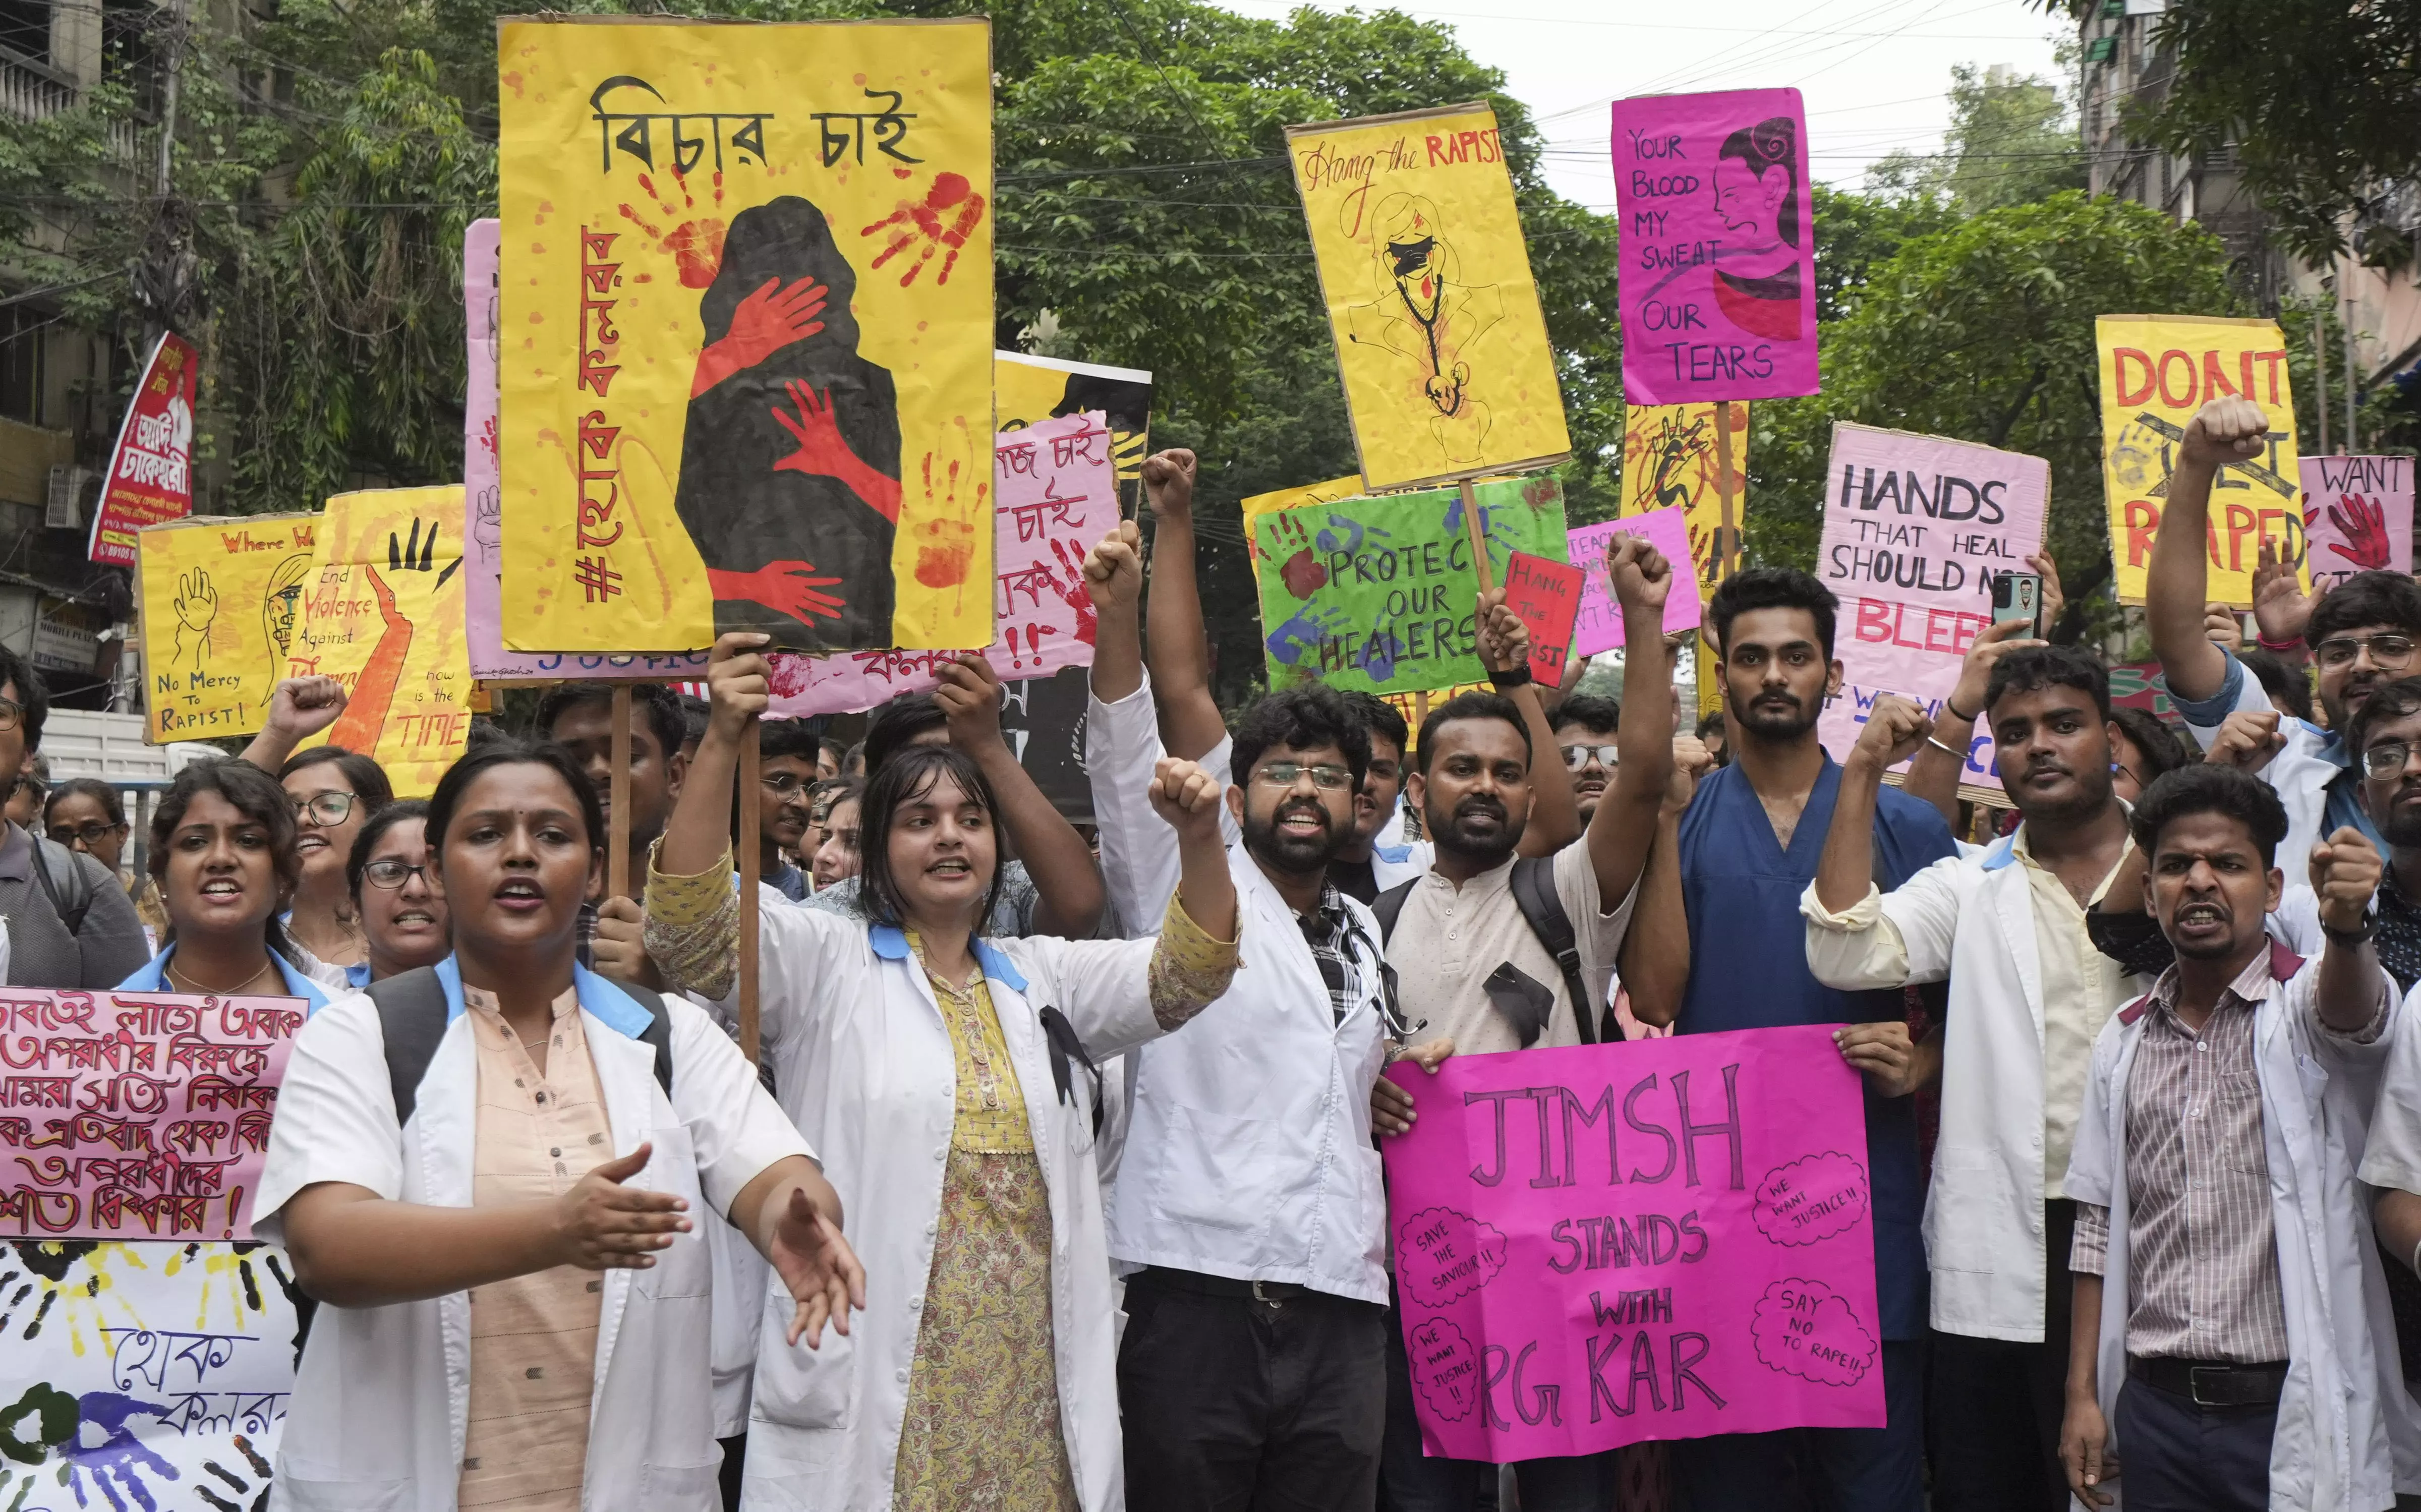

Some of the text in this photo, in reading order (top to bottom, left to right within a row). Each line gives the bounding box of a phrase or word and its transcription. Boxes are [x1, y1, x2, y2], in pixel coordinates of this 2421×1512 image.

[590, 75, 926, 176] বিচার চাই
[1628, 128, 1687, 160] YOUR
[1299, 129, 1503, 239] Hang the RAPIST
[1632, 169, 1699, 199] BLOOD
[1635, 210, 1669, 237] MY
[1641, 240, 1722, 270] SWEAT
[578, 225, 622, 397] কলরব
[1643, 300, 1707, 331] OUR
[1665, 341, 1773, 382] TEARS
[1049, 414, 1107, 468] চাই
[2319, 456, 2406, 493] WANT
[1011, 476, 1088, 543] চাই
[1840, 464, 2007, 525] HANDS
[221, 531, 284, 554] Where
[1851, 519, 2016, 559] THAT HEAL
[2125, 500, 2305, 573] RPED
[320, 563, 351, 584] End
[1512, 559, 1566, 597] HANG
[1829, 544, 1966, 591] SHOULD
[305, 587, 373, 623] Violence
[1387, 584, 1453, 618] OUR
[1519, 601, 1547, 621] THE
[298, 627, 354, 653] Against
[1319, 614, 1477, 674] HEALERS
[157, 671, 242, 694] No Mercy
[426, 670, 455, 681] now
[415, 687, 454, 703] is the
[396, 713, 470, 747] TIME
[220, 1000, 304, 1040] অবাক
[162, 1119, 230, 1156] হোক
[1464, 1064, 1746, 1190] JIMSH
[1769, 1179, 1790, 1197] WE
[1772, 1191, 1807, 1216] WANT
[1416, 1220, 1449, 1251] SAVE
[1548, 1210, 1709, 1274] STANDS
[1433, 1243, 1456, 1265] THE
[1589, 1287, 1673, 1327] WITH
[1781, 1290, 1822, 1316] SAY
[1419, 1328, 1440, 1348] WE
[1783, 1335, 1801, 1350] TO
[1790, 1317, 1813, 1335] NO
[99, 1328, 260, 1392] হোক
[1426, 1345, 1455, 1366] WANT
[1433, 1360, 1472, 1387] JUSTICE
[1480, 1330, 1727, 1432] RG KAR
